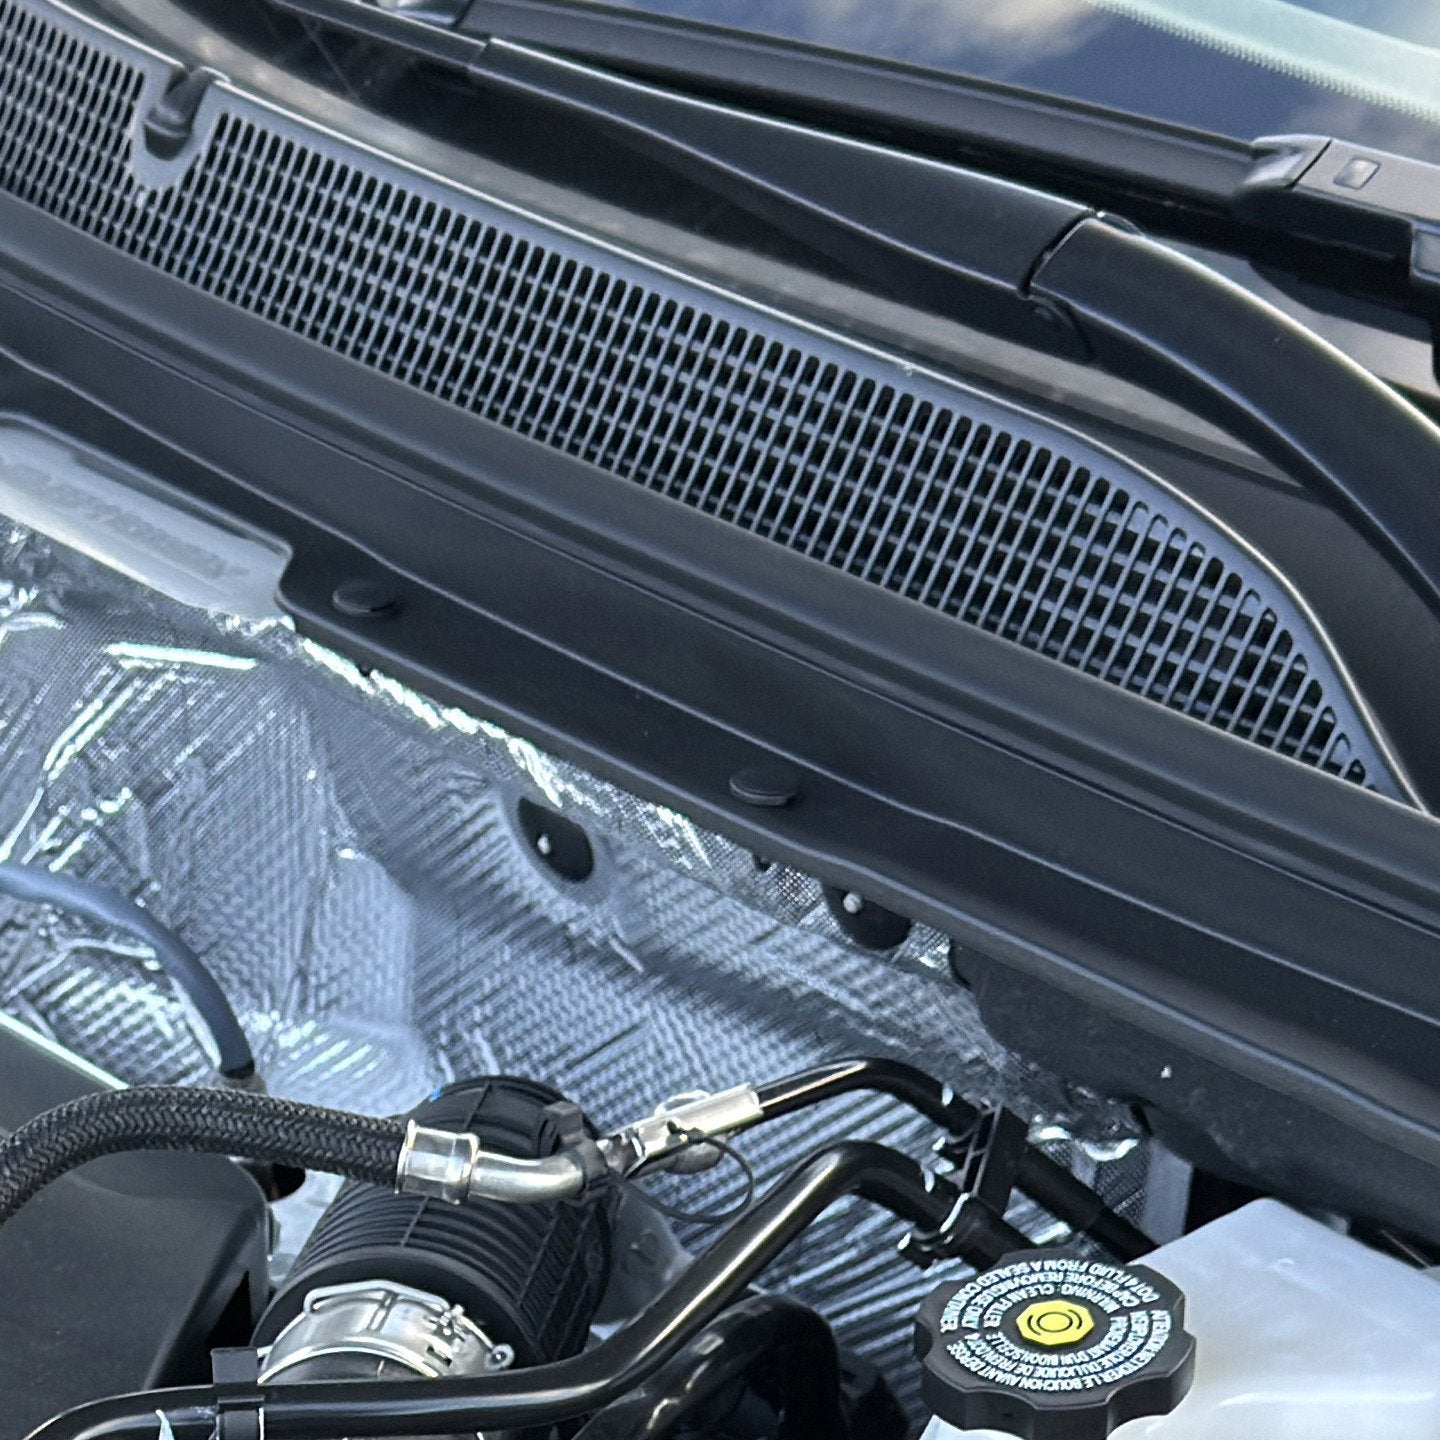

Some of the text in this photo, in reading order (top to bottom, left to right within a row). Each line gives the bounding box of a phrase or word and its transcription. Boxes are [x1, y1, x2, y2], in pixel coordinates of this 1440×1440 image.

[976, 1262, 1030, 1286] SEALED
[1030, 1261, 1042, 1271] A
[1044, 1259, 1089, 1272] FROM
[1089, 1263, 1131, 1284] FLUID
[989, 1269, 1064, 1295] REMOVING
[1065, 1270, 1119, 1293] BEFORE
[971, 1290, 998, 1308] USE
[1006, 1284, 1054, 1302] CLEAN
[1130, 1283, 1159, 1302] DOT
[941, 1283, 982, 1332] CONTAINER
[982, 1350, 1018, 1371] FREIN
[1020, 1351, 1058, 1365] BIDON
[1097, 1352, 1124, 1368] QUE
[978, 1366, 1022, 1386] AVANT
[1014, 1363, 1034, 1376] DE
[1033, 1366, 1083, 1378] LIQUIDE
[1081, 1361, 1102, 1374] DU
[1019, 1377, 1082, 1391] BOUCHON
[1082, 1375, 1101, 1388] LE
